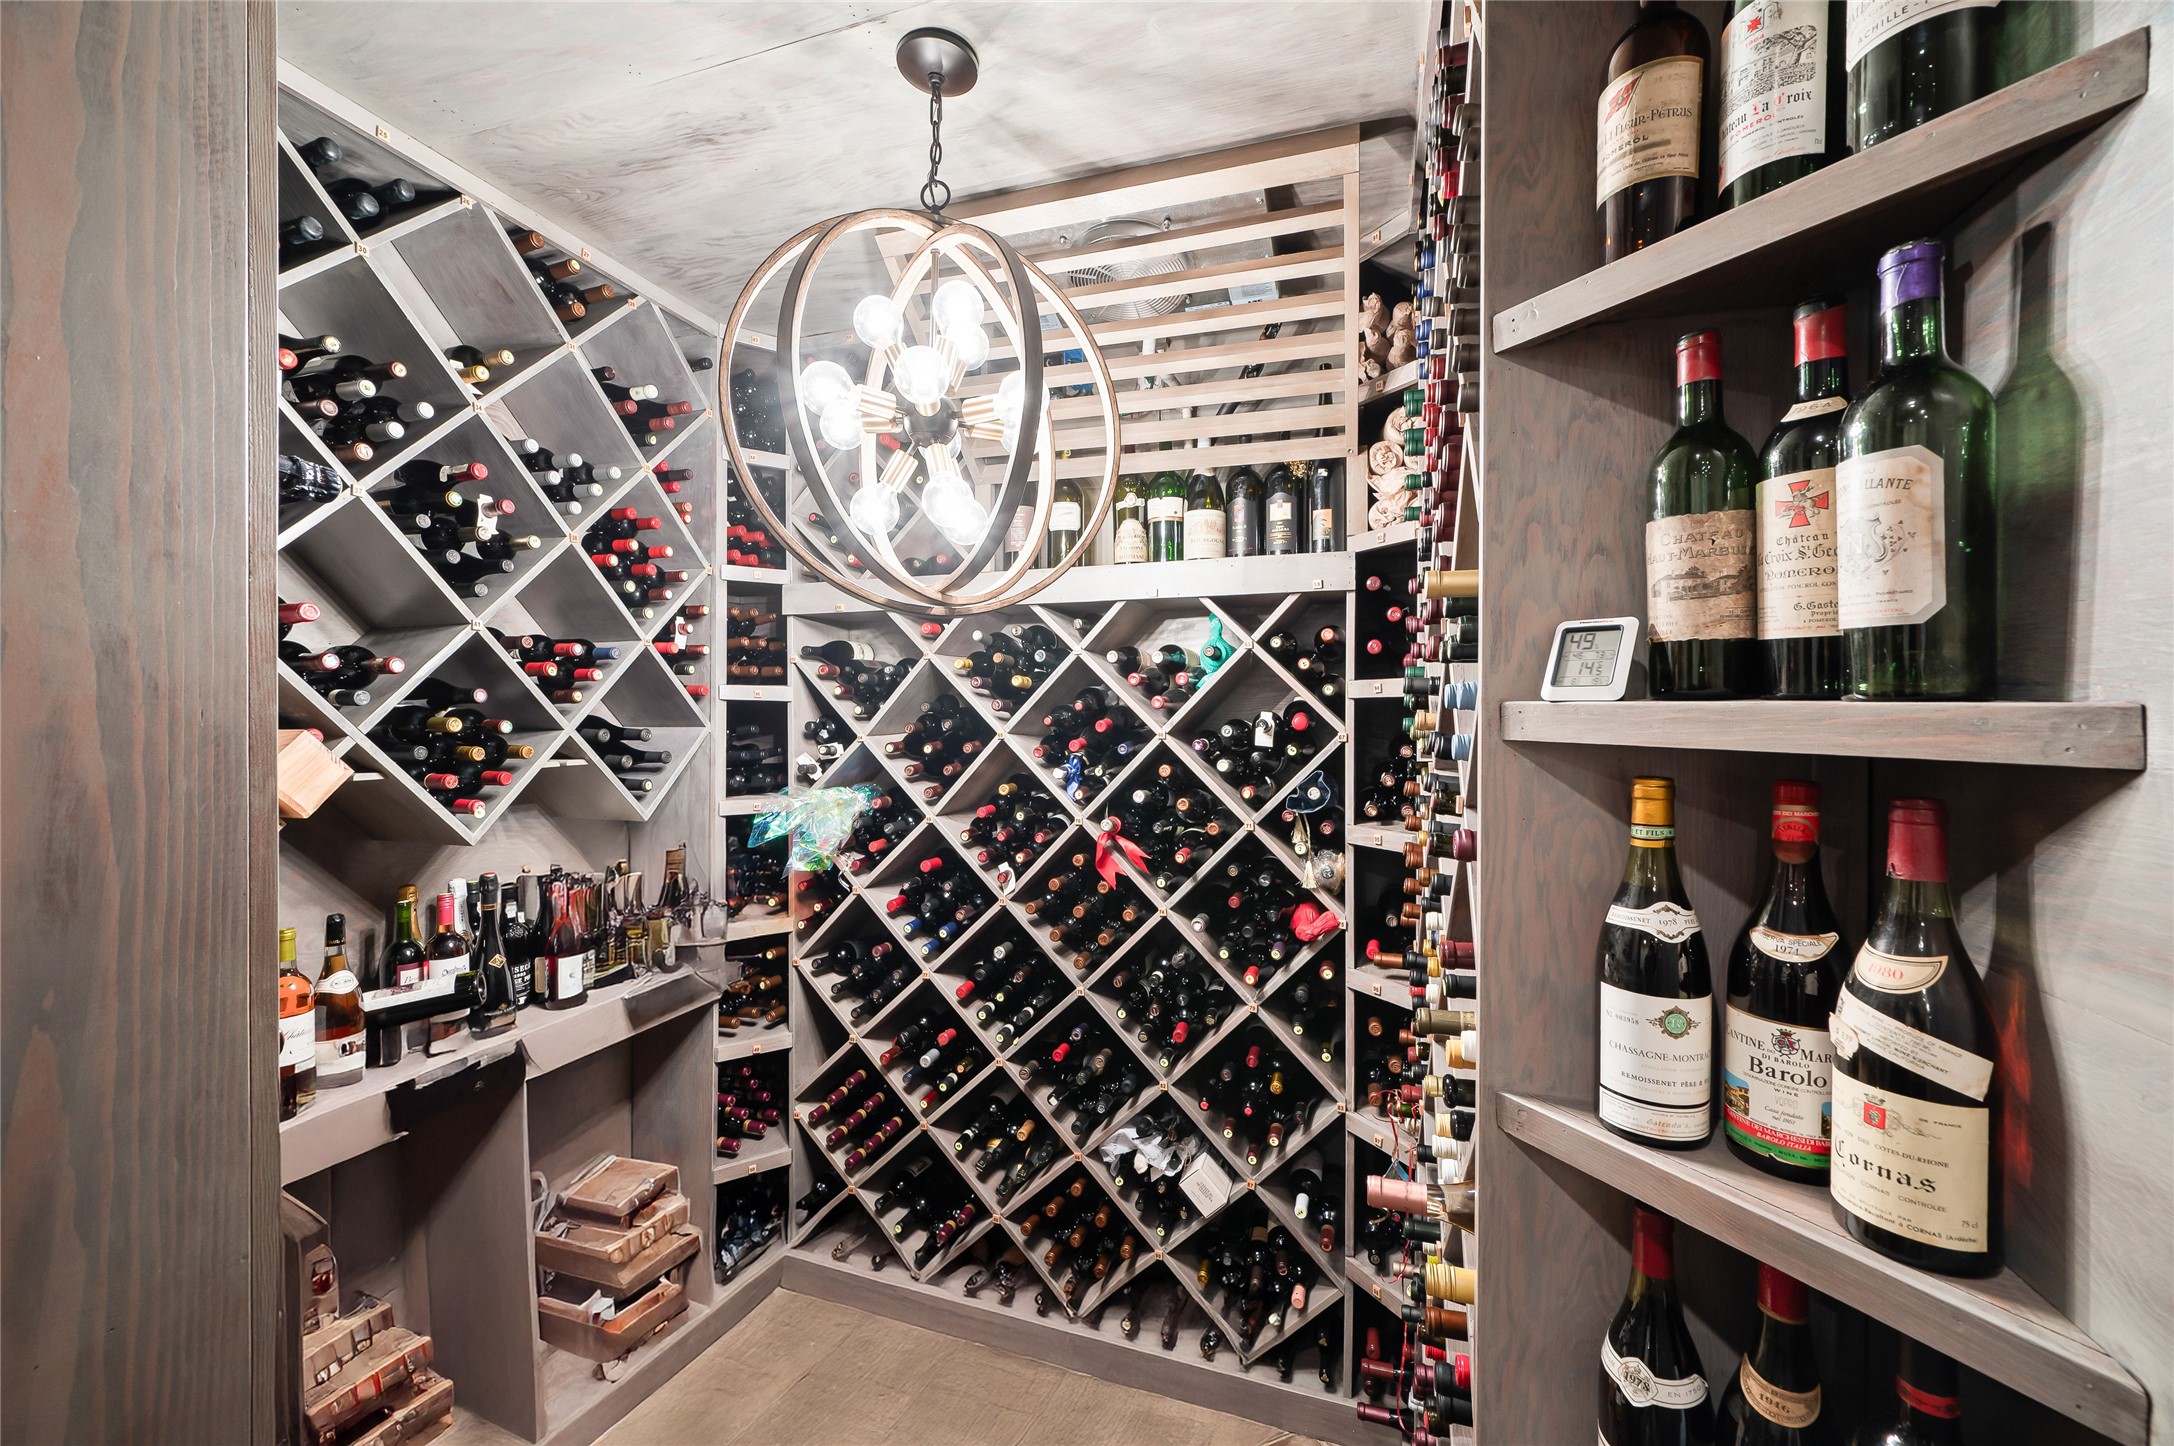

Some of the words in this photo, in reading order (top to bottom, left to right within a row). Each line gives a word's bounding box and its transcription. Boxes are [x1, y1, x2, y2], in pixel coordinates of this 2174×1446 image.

[1858, 4, 1909, 45] ACHILLE
[379, 130, 387, 139] 25
[1729, 113, 1777, 142] POMEROL
[1602, 135, 1649, 164] POMEROL
[463, 197, 470, 206] 26
[359, 245, 366, 254] 30
[1776, 532, 1830, 546] Château
[1570, 632, 1597, 650] 49
[1659, 918, 1678, 928] 1978
[1788, 940, 1822, 948] SPECIALE
[1868, 962, 1904, 980] 1980
[1726, 1022, 1766, 1052] CANTINE
[1762, 1052, 1770, 1060] DI
[1774, 1054, 1810, 1068] BAROLO
[1621, 1070, 1678, 1088] REMOISSENET
[1680, 1079, 1697, 1088] PÈRE
[1748, 1055, 1828, 1088] Barolo
[1774, 1088, 1799, 1098] WINE
[1726, 1109, 1750, 1127] CANTINE
[1752, 1122, 1763, 1133] DEI
[1764, 1126, 1806, 1145] MARCHESI
[1756, 1132, 1786, 1146] BAROLO
[1786, 1142, 1812, 1152] ITALIA
[1834, 1136, 1936, 1194] Cornas
[1860, 1180, 1890, 1196] CORNAS
[1906, 1224, 1943, 1239] CORNAS
[1622, 1371, 1651, 1392] 1978
